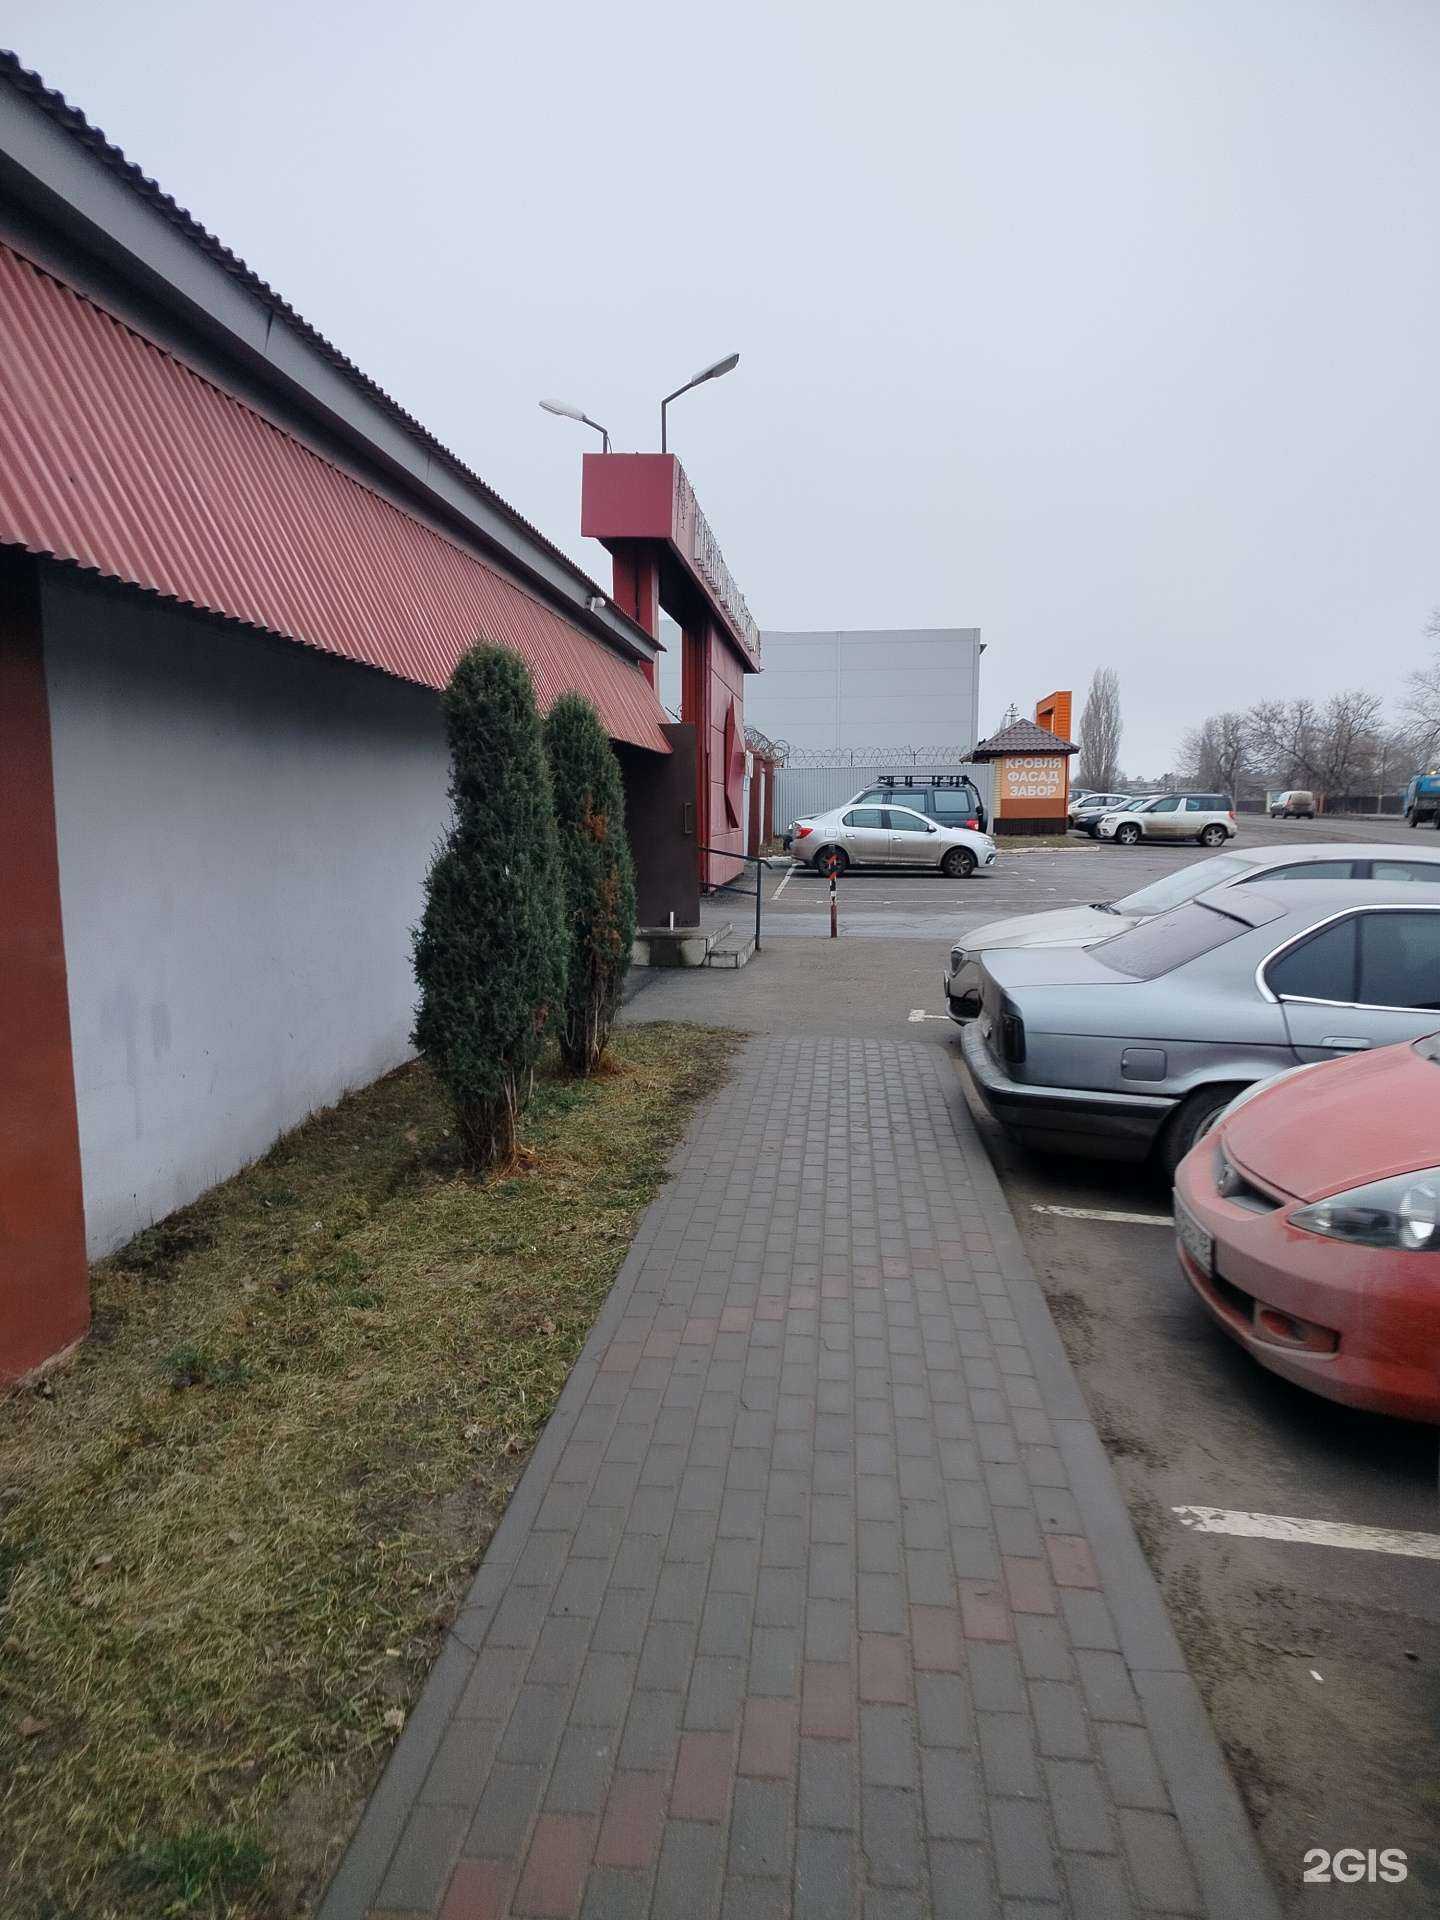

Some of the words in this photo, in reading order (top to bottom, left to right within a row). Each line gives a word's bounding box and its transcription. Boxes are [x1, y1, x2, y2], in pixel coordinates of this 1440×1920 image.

[1005, 757, 1062, 769] КРОВЛЯ
[1007, 771, 1060, 784] ФАСАД
[1010, 785, 1057, 796] ЗАБОР
